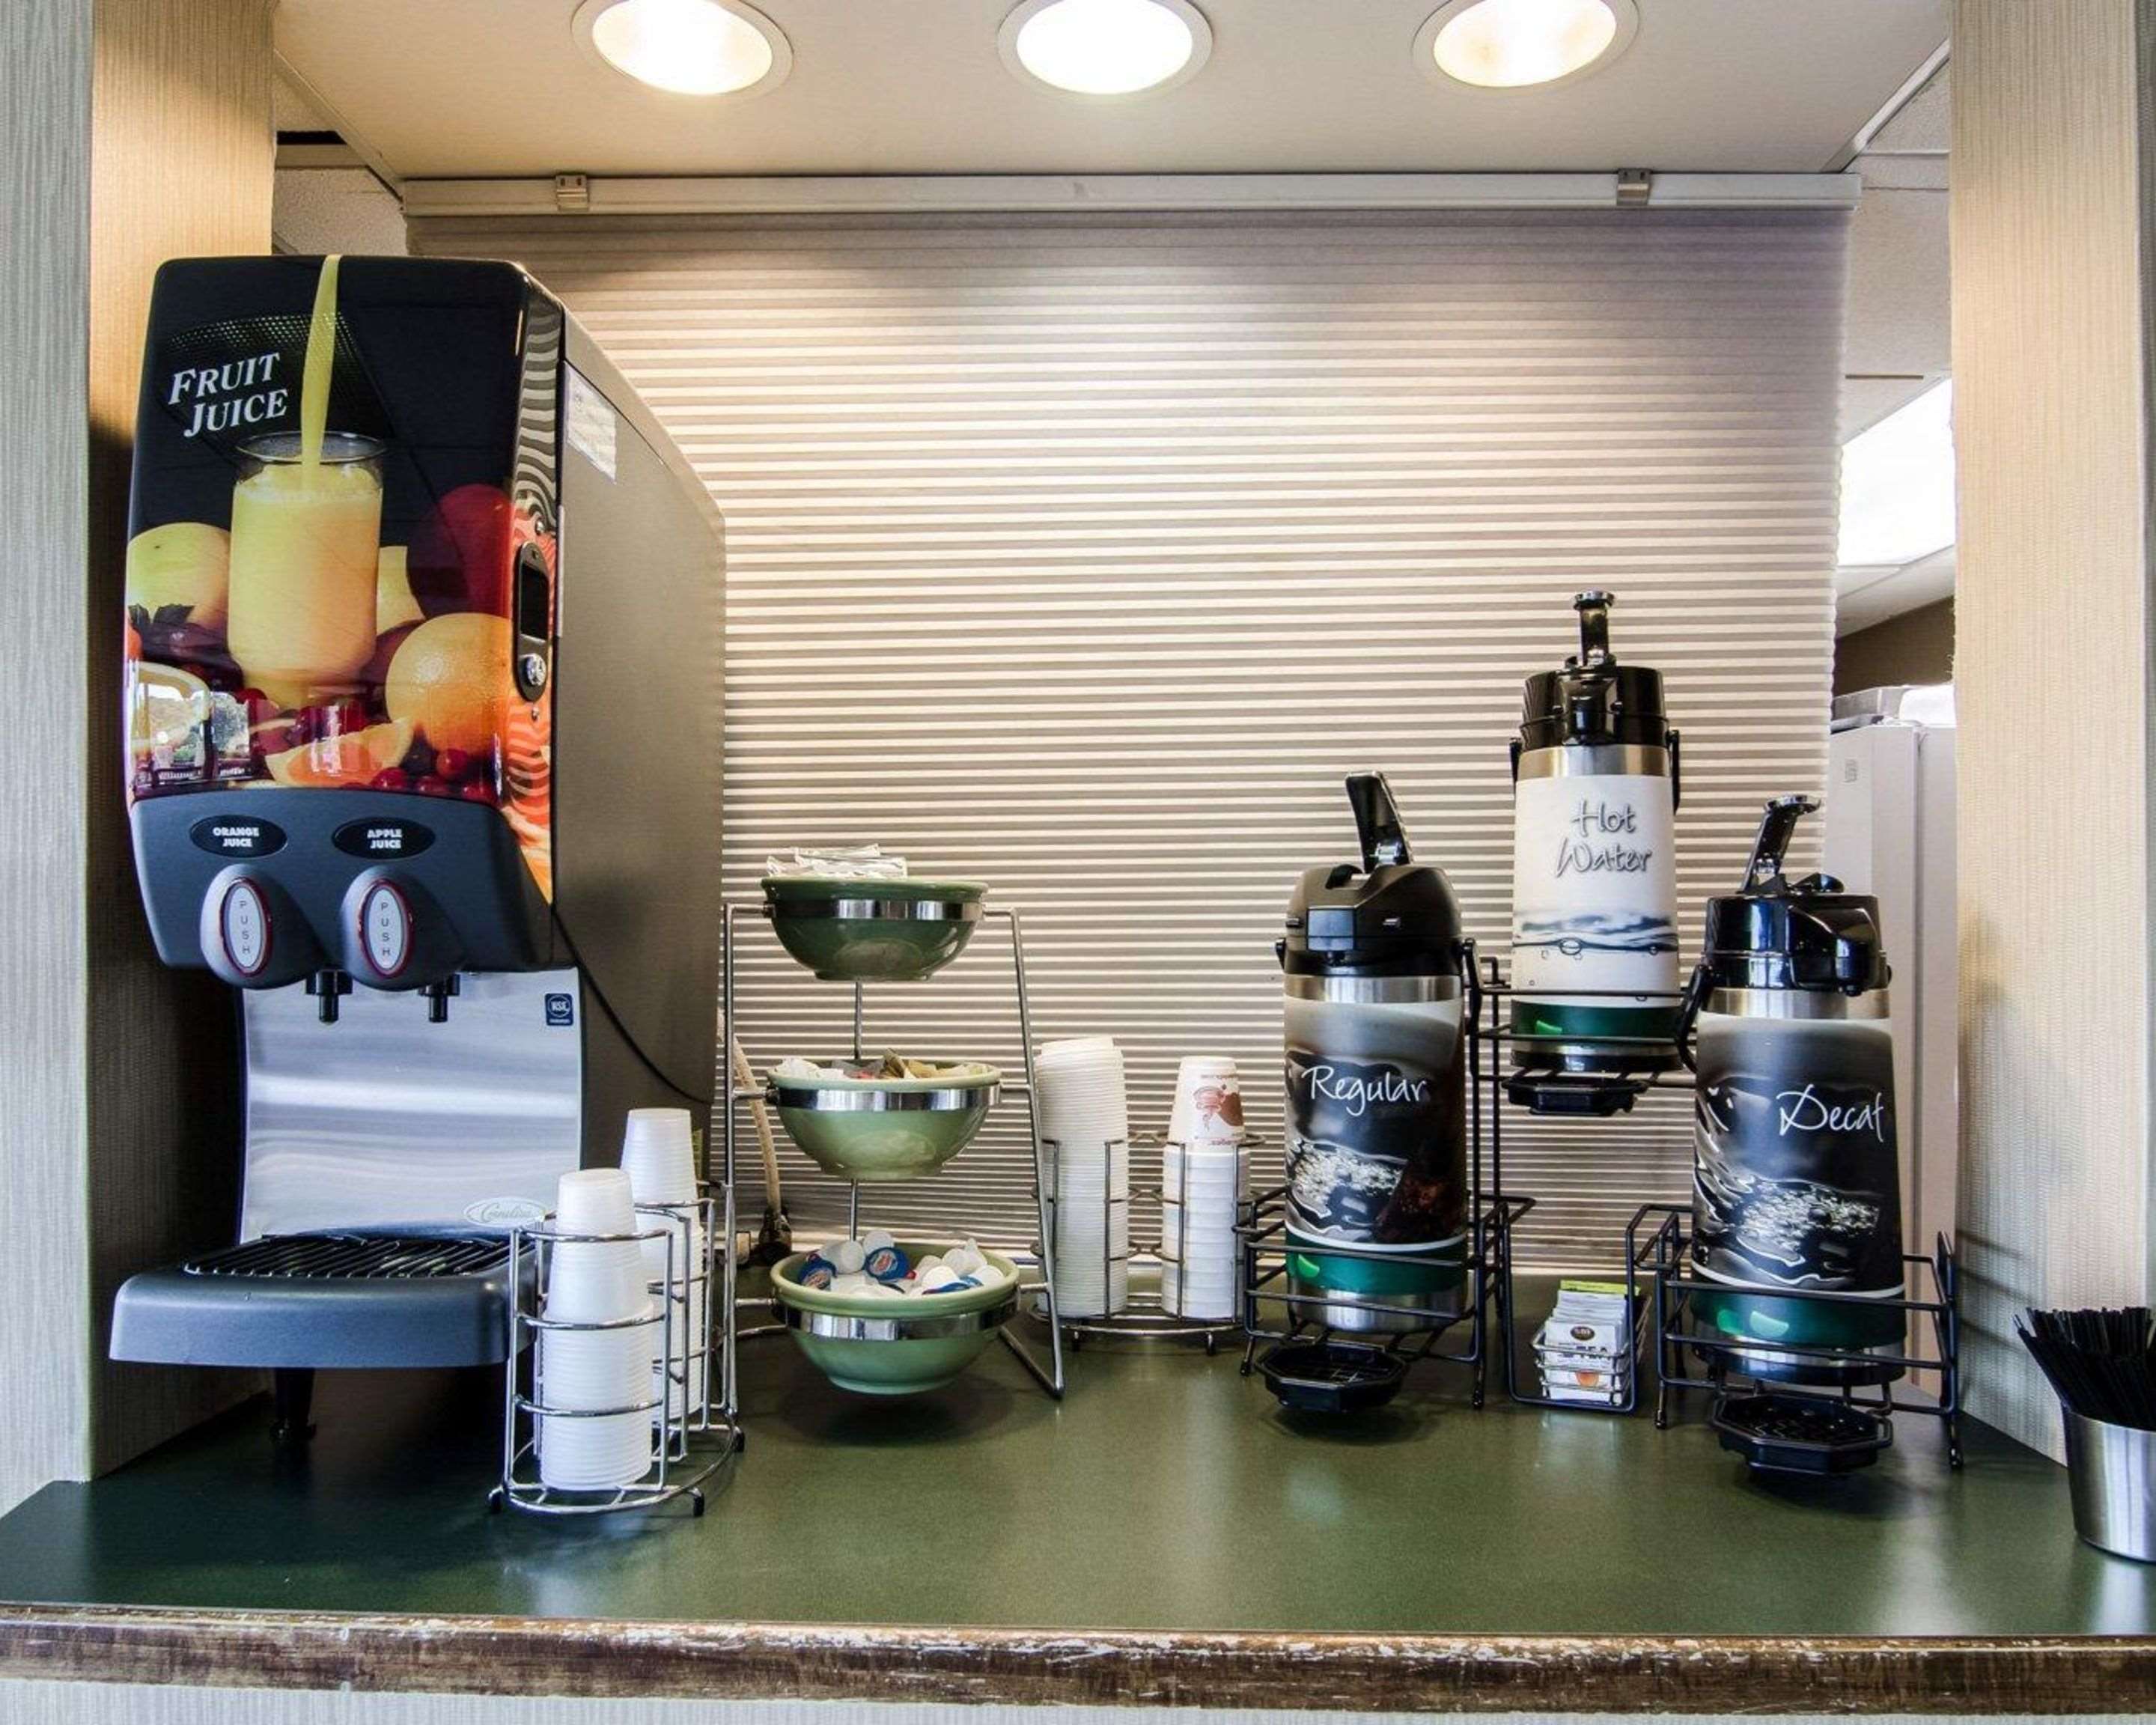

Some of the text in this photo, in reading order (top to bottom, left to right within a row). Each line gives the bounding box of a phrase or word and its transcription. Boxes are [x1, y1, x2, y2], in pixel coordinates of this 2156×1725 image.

[168, 353, 280, 404] FRUIT
[183, 389, 288, 437] JUICE
[213, 827, 260, 837] ORANGE
[367, 829, 403, 839] APPLE
[1572, 800, 1636, 837] Hot
[222, 838, 252, 848] JUICE
[370, 839, 402, 849] JUICE
[1556, 838, 1653, 878] Water
[239, 901, 251, 954] PUSH
[380, 902, 391, 956] PUSH
[1301, 1065, 1427, 1116] Regular
[1776, 1084, 1884, 1143] Decaf
